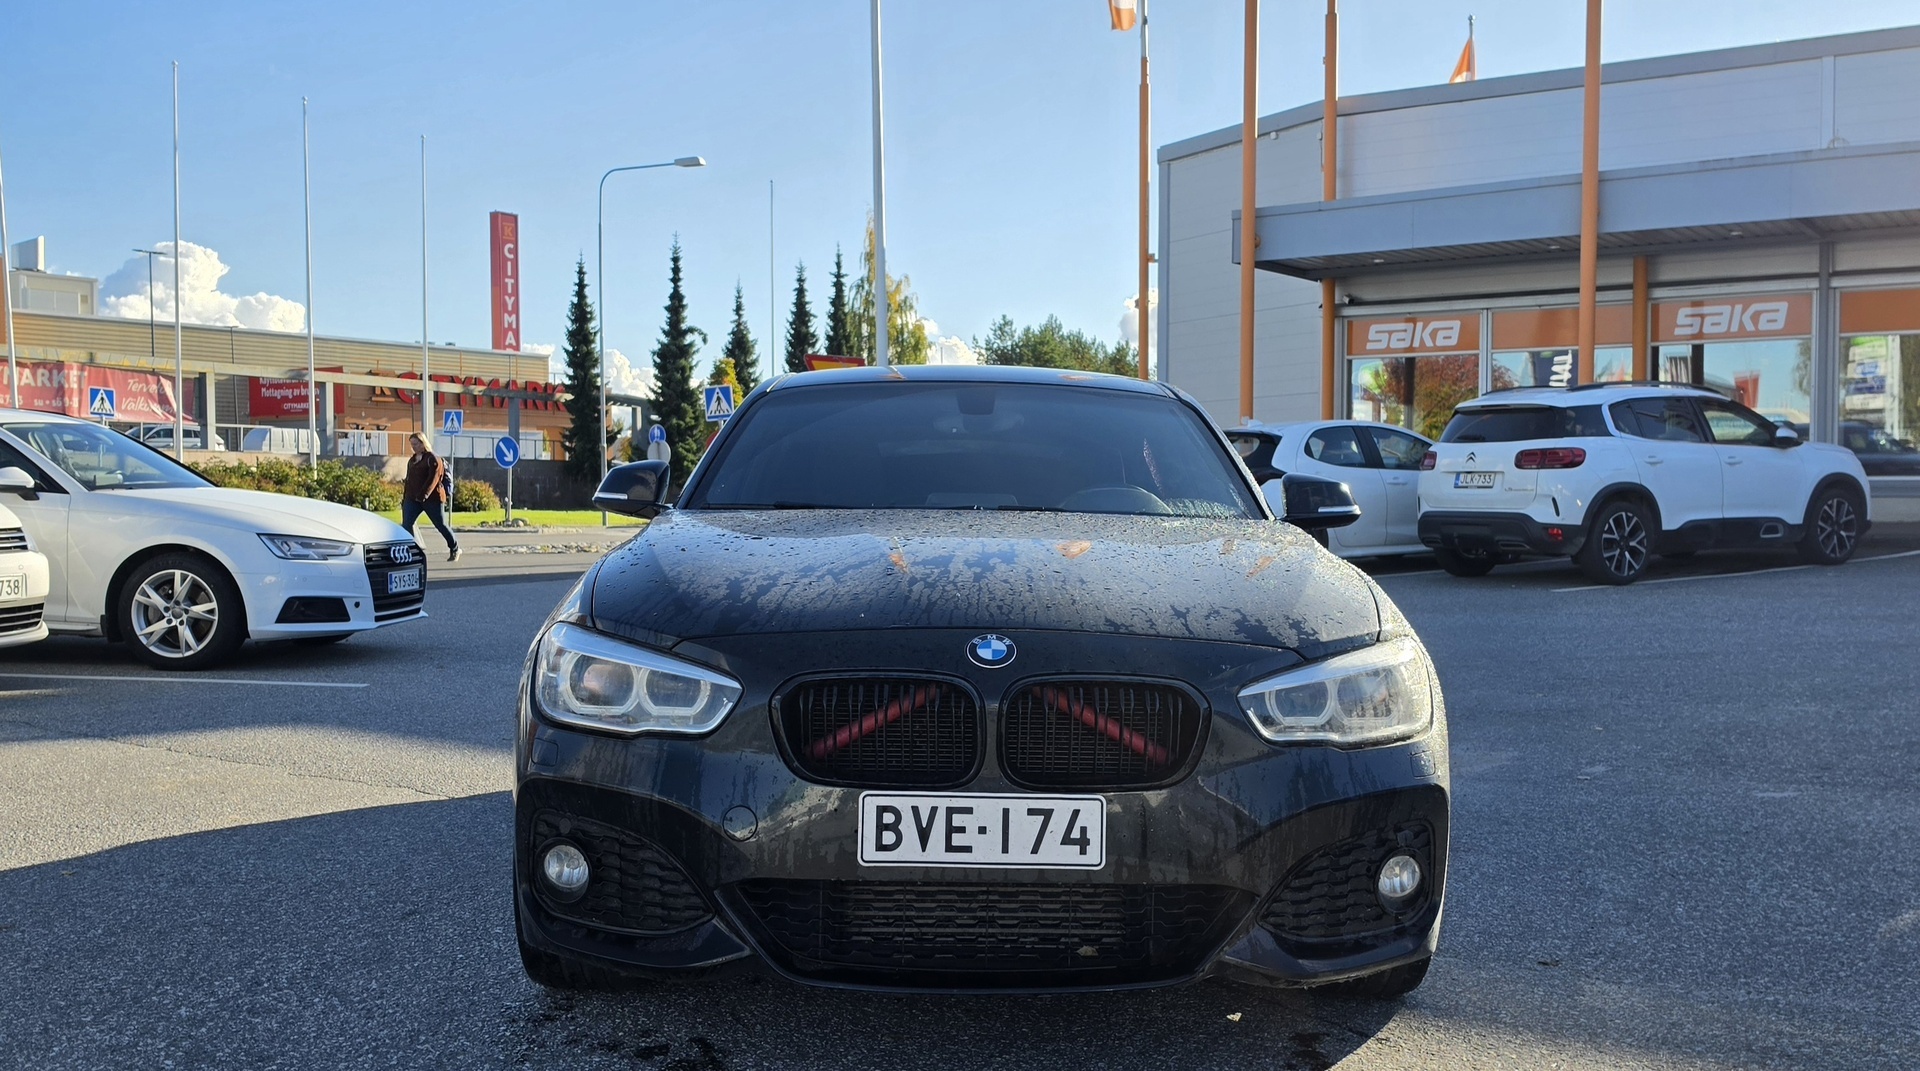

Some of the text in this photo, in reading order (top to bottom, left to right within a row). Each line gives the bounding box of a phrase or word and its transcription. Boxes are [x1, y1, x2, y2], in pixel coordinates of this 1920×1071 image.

[504, 243, 516, 351] CITYMA
[283, 402, 309, 410] CITYMARKE
[1459, 474, 1493, 485] JLK-733
[393, 573, 419, 589] SYS-324
[972, 634, 1012, 646] BMW
[874, 804, 1091, 856] BVE-174
